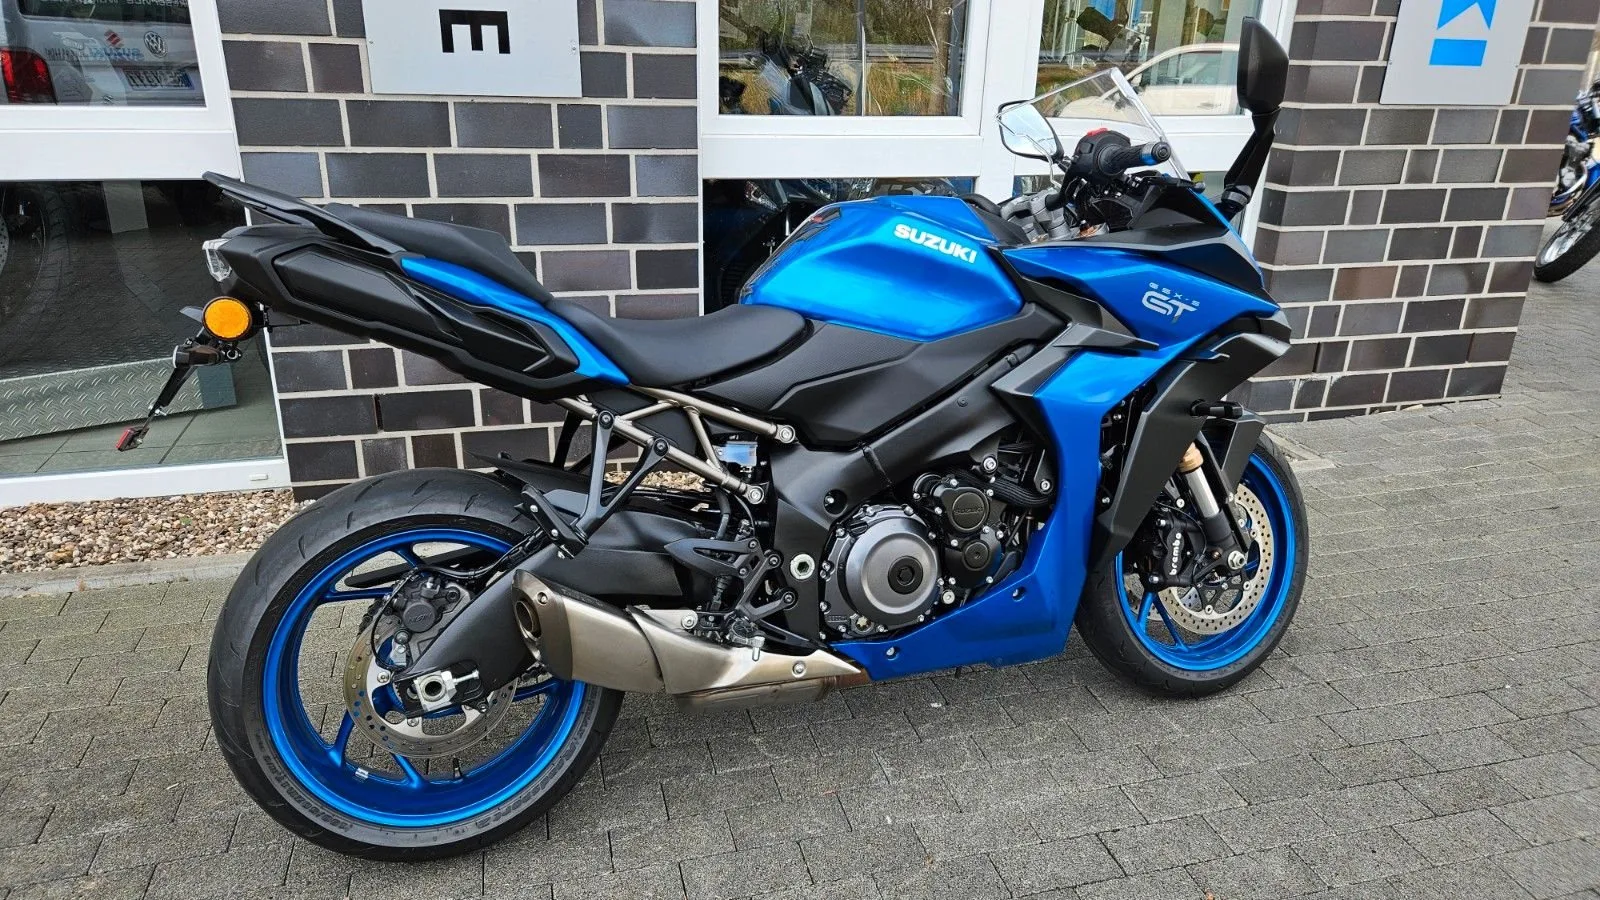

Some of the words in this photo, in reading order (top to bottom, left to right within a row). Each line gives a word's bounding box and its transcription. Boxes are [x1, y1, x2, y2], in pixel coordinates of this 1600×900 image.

[438, 8, 511, 55] E
[893, 223, 978, 264] SUZUKI
[1141, 290, 1198, 324] GT
[1168, 532, 1182, 576] brembo
